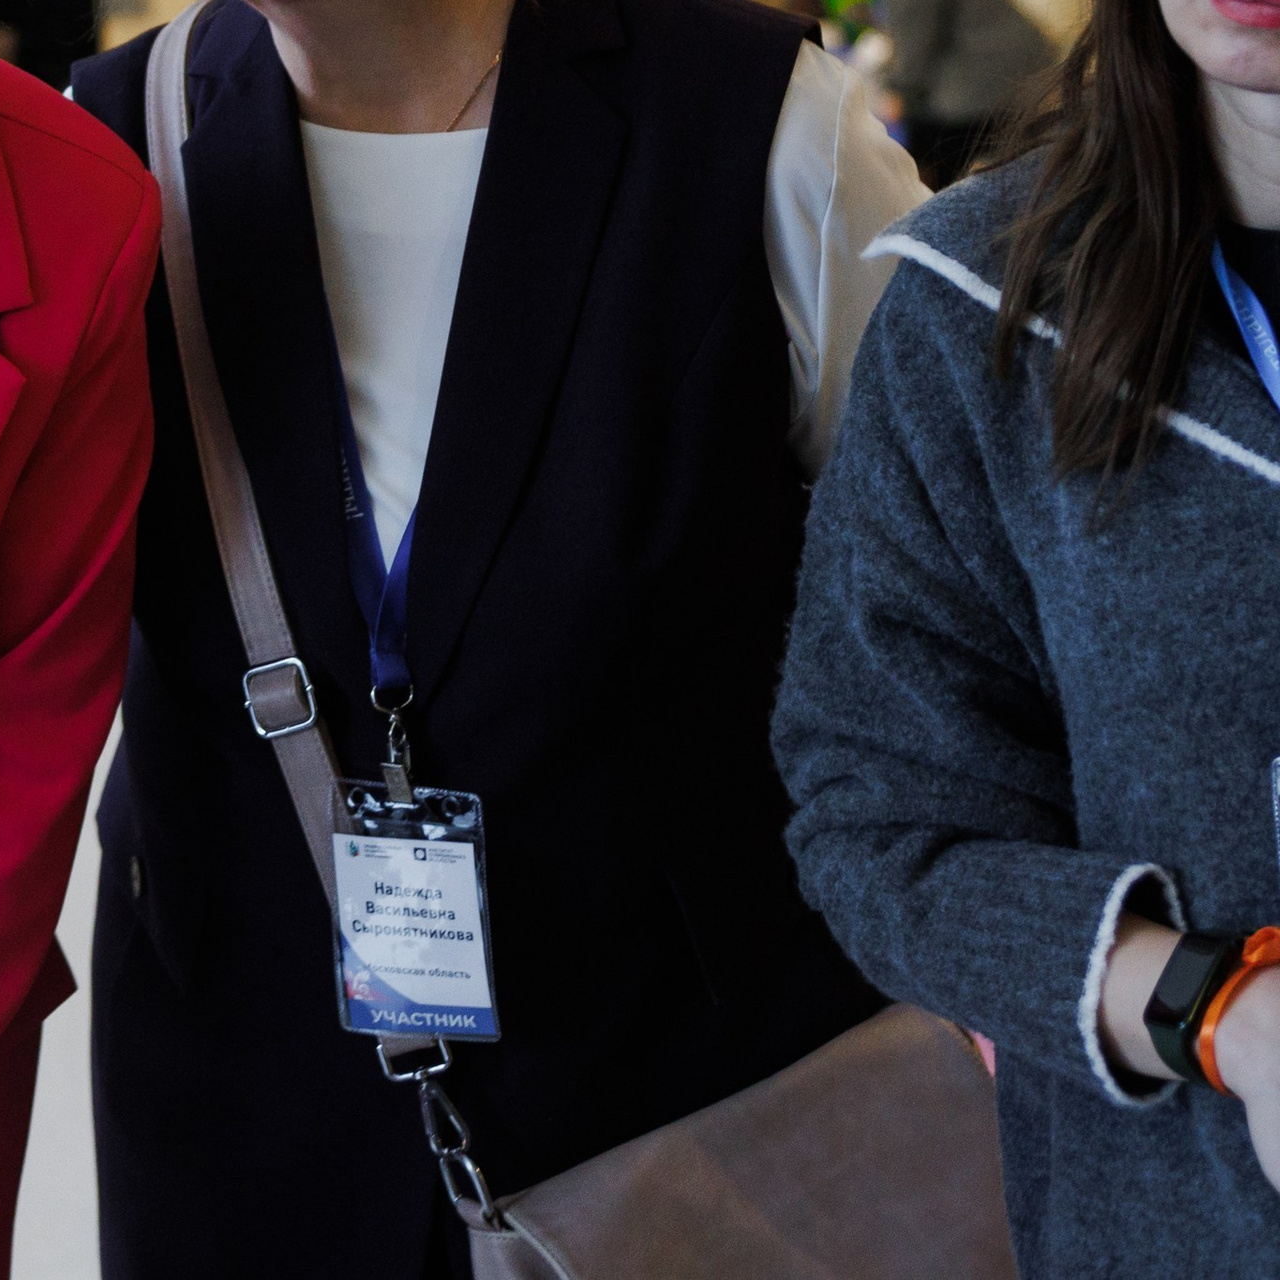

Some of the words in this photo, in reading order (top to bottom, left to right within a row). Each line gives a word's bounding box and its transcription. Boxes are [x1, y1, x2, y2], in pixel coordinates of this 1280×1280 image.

[374, 881, 443, 900] Надежда
[365, 901, 456, 920] Васильевна
[352, 919, 474, 941] Сыромятникова
[428, 967, 472, 979] область
[371, 1009, 477, 1029] УЧАСТНИК
